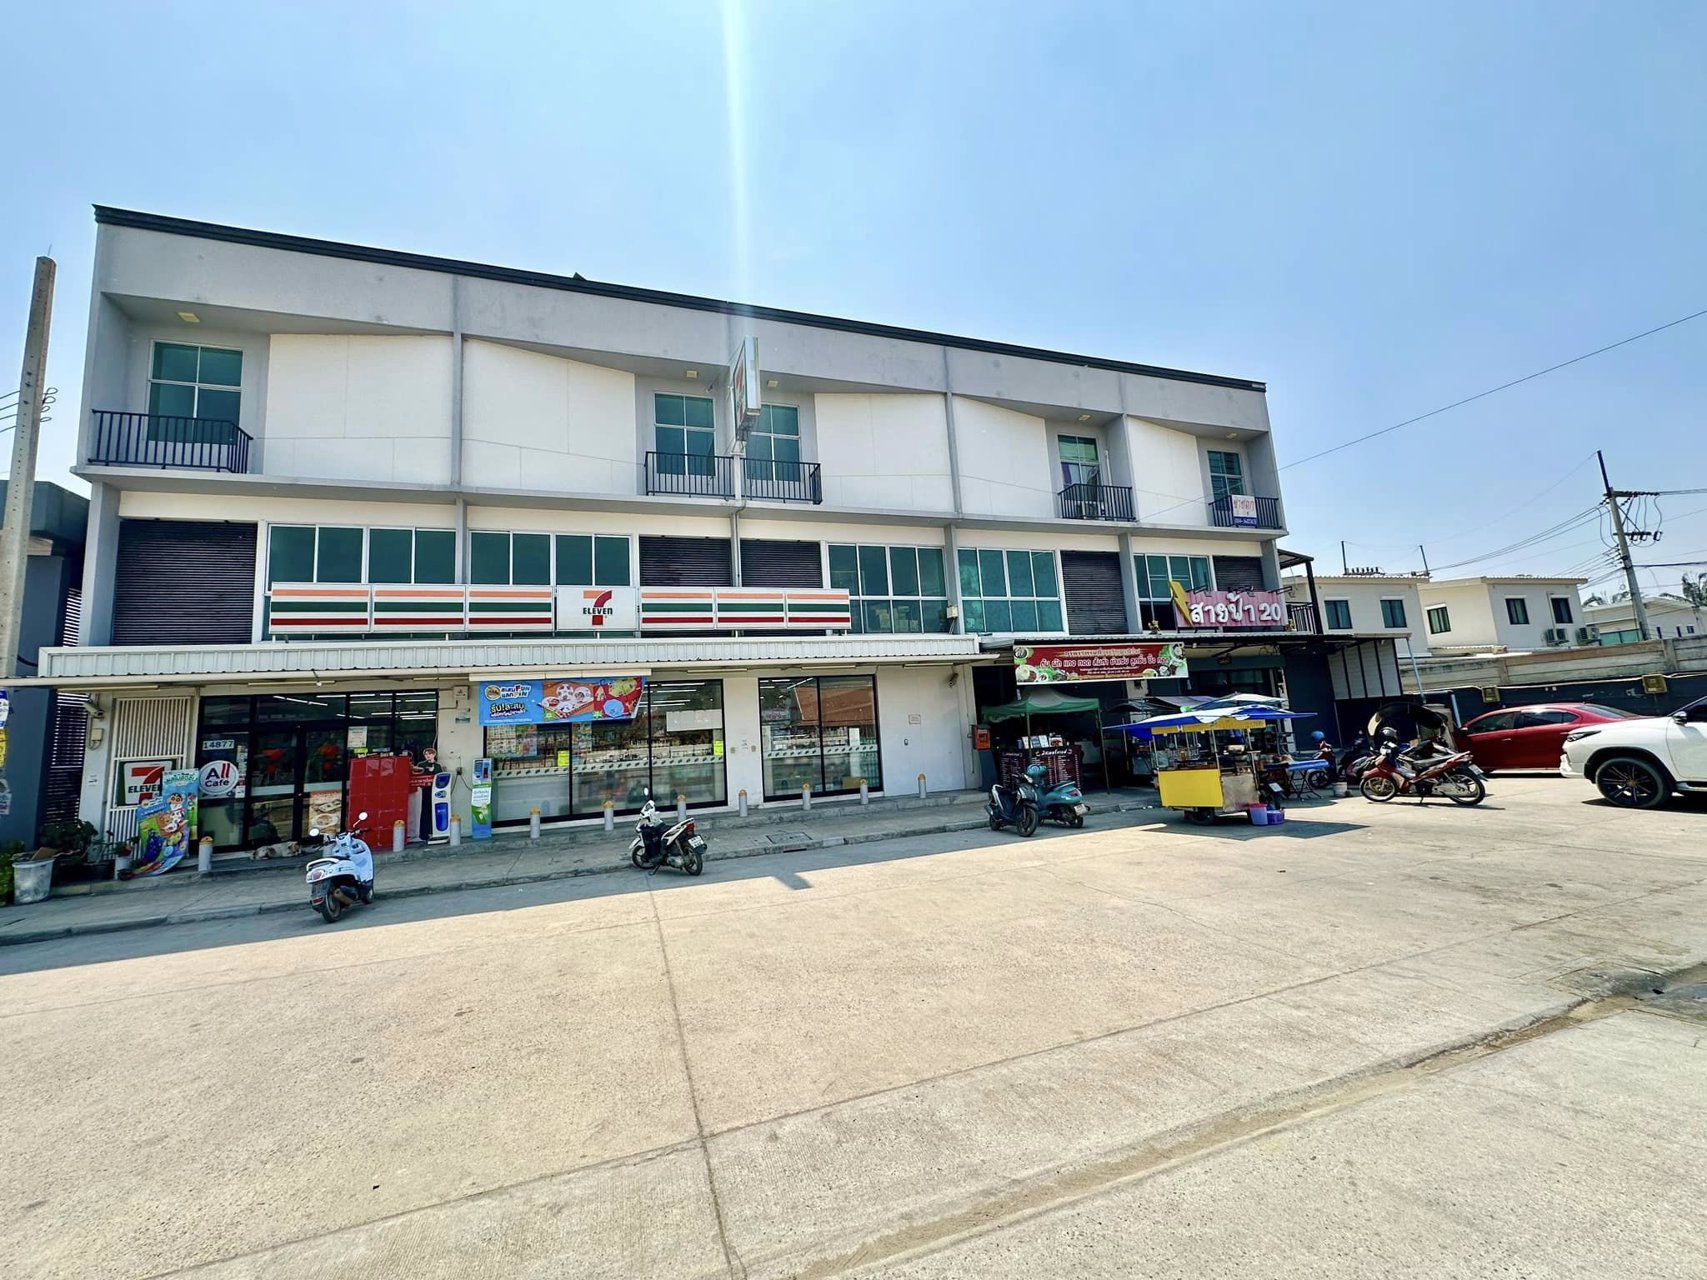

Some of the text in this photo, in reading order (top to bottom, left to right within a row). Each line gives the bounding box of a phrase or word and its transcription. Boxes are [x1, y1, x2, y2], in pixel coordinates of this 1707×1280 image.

[583, 590, 612, 625] 7
[1190, 592, 1281, 624] สายฟ้า 20
[204, 741, 233, 749] 14877
[131, 765, 165, 803] 7
[204, 779, 230, 788] Cafe
